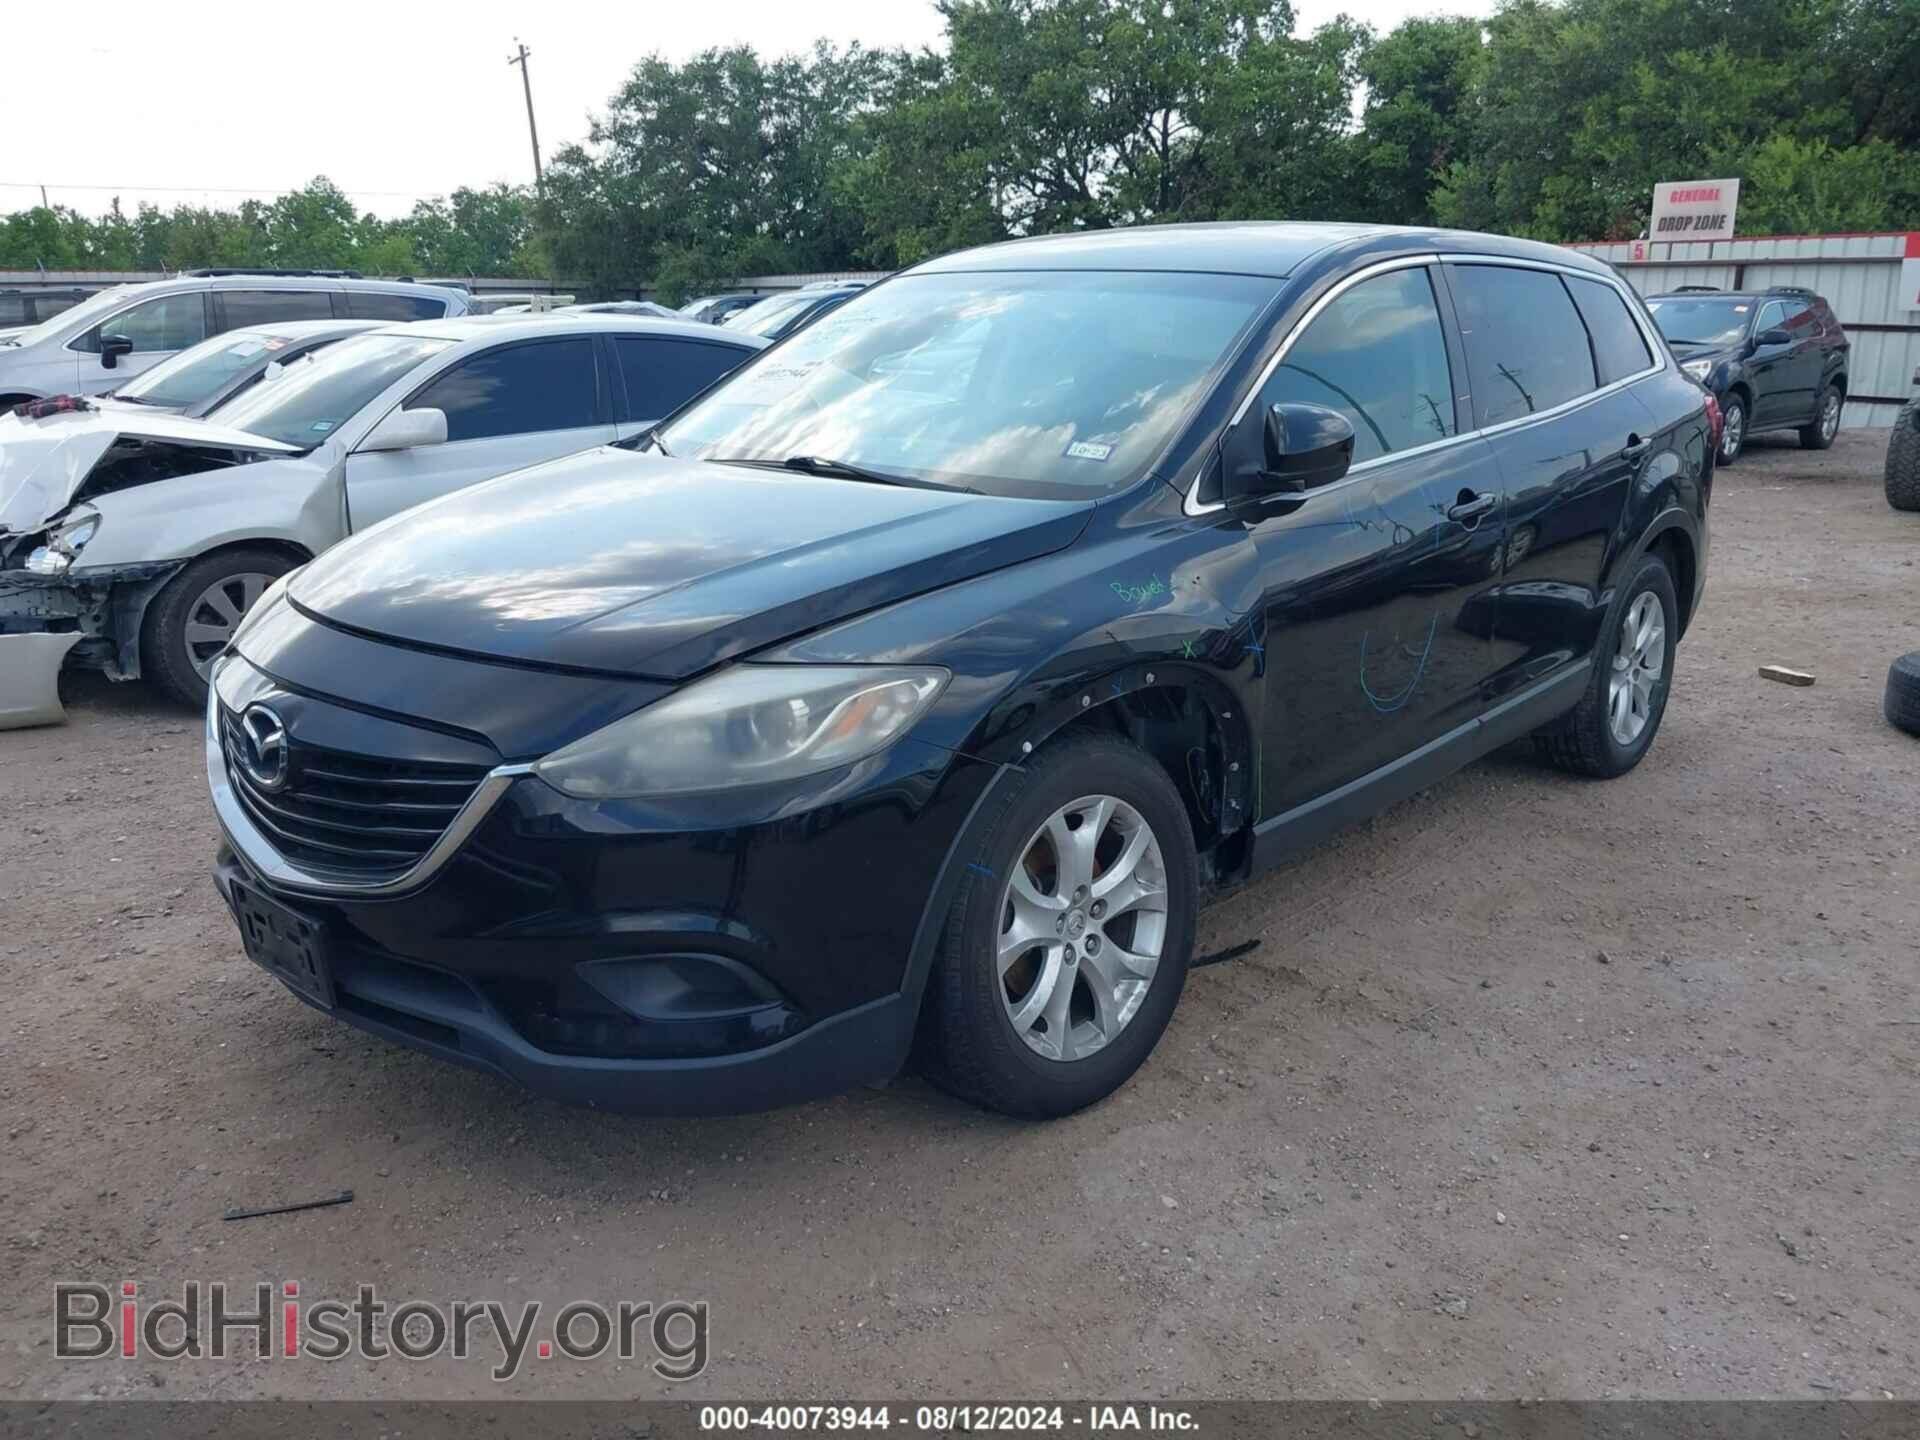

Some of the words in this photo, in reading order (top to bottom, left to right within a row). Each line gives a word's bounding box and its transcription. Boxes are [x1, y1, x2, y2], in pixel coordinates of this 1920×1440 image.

[1669, 188, 1720, 204] GENERAL
[1657, 216, 1693, 232] DROP
[1693, 214, 1727, 231] ZONE
[1634, 243, 1644, 260] 5
